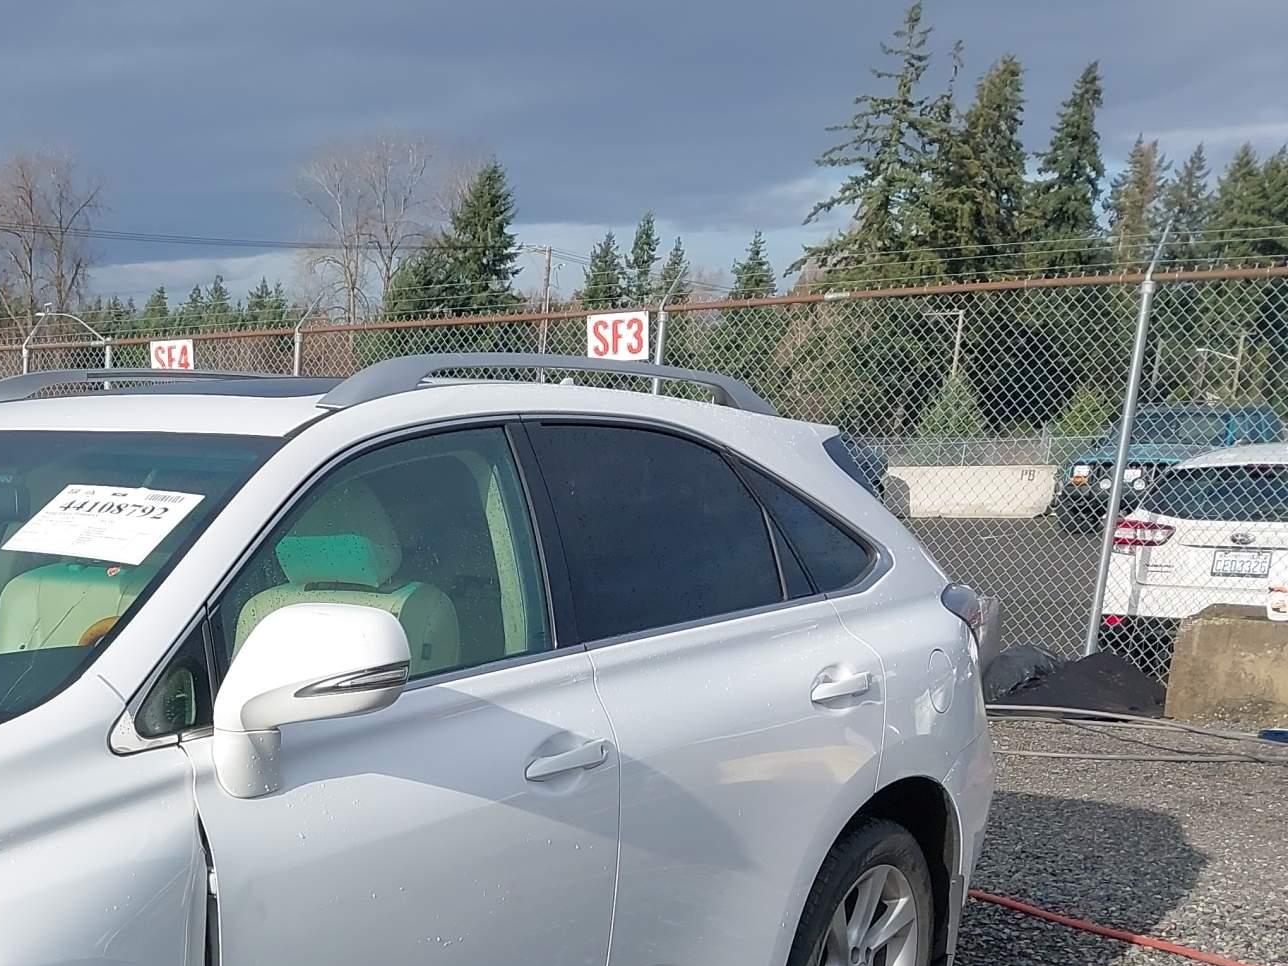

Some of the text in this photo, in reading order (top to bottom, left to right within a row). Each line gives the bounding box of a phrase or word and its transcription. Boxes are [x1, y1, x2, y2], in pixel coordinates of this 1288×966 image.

[593, 318, 643, 356] SF3
[154, 345, 190, 369] SF4
[59, 500, 169, 520] 44108792
